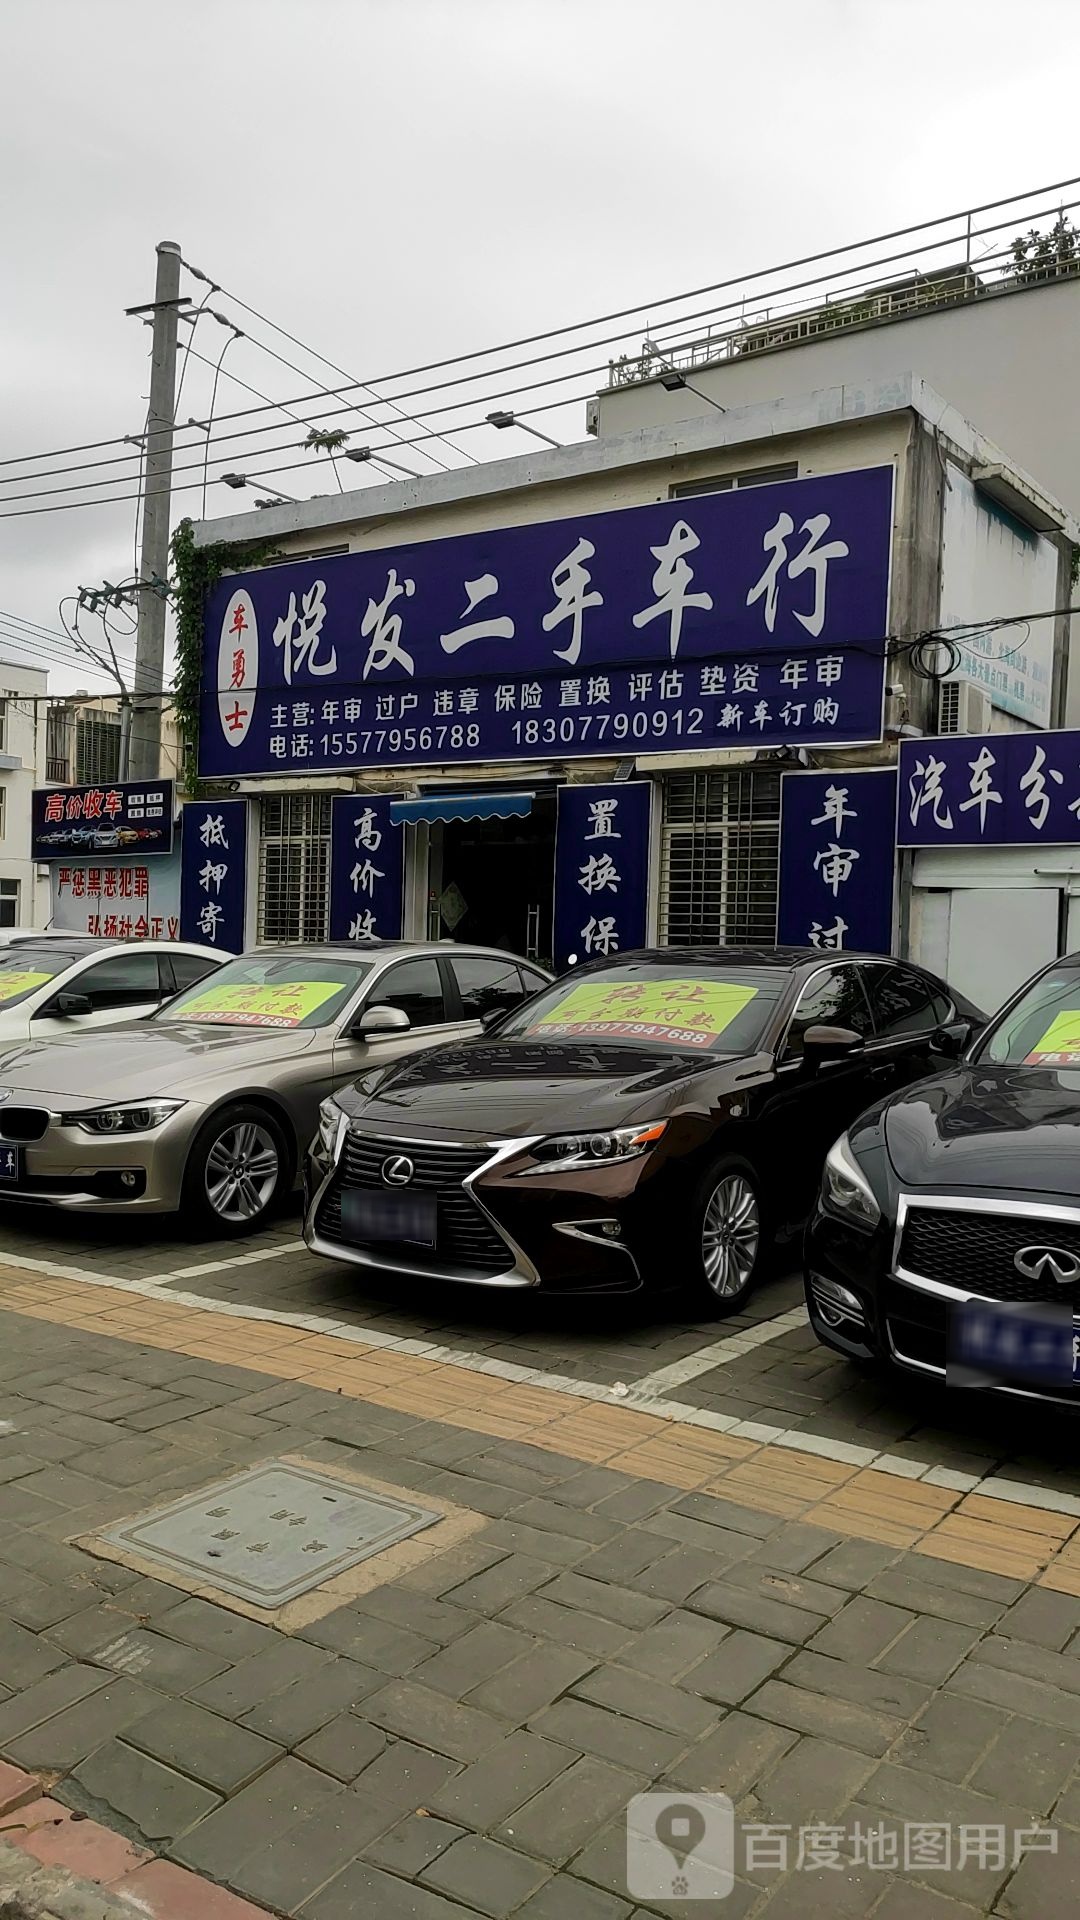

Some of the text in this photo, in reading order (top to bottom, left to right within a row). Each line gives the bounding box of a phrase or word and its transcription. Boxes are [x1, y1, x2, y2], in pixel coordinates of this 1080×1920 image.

[273, 512, 849, 686] 悦发二手车行
[225, 603, 249, 731] 车勇士
[375, 693, 418, 721] 过户
[432, 688, 480, 716] 违章
[494, 682, 543, 713] 保险
[558, 676, 611, 707] 置换
[628, 669, 684, 702] 评估
[699, 663, 760, 696] 垫资
[779, 655, 844, 690] 年审
[511, 708, 704, 744] 18307790912
[716, 697, 840, 733] 新车订购
[44, 789, 123, 823] 高价收车
[909, 745, 1080, 835] 汽车分
[57, 866, 149, 898] 严惩黑恶犯罪
